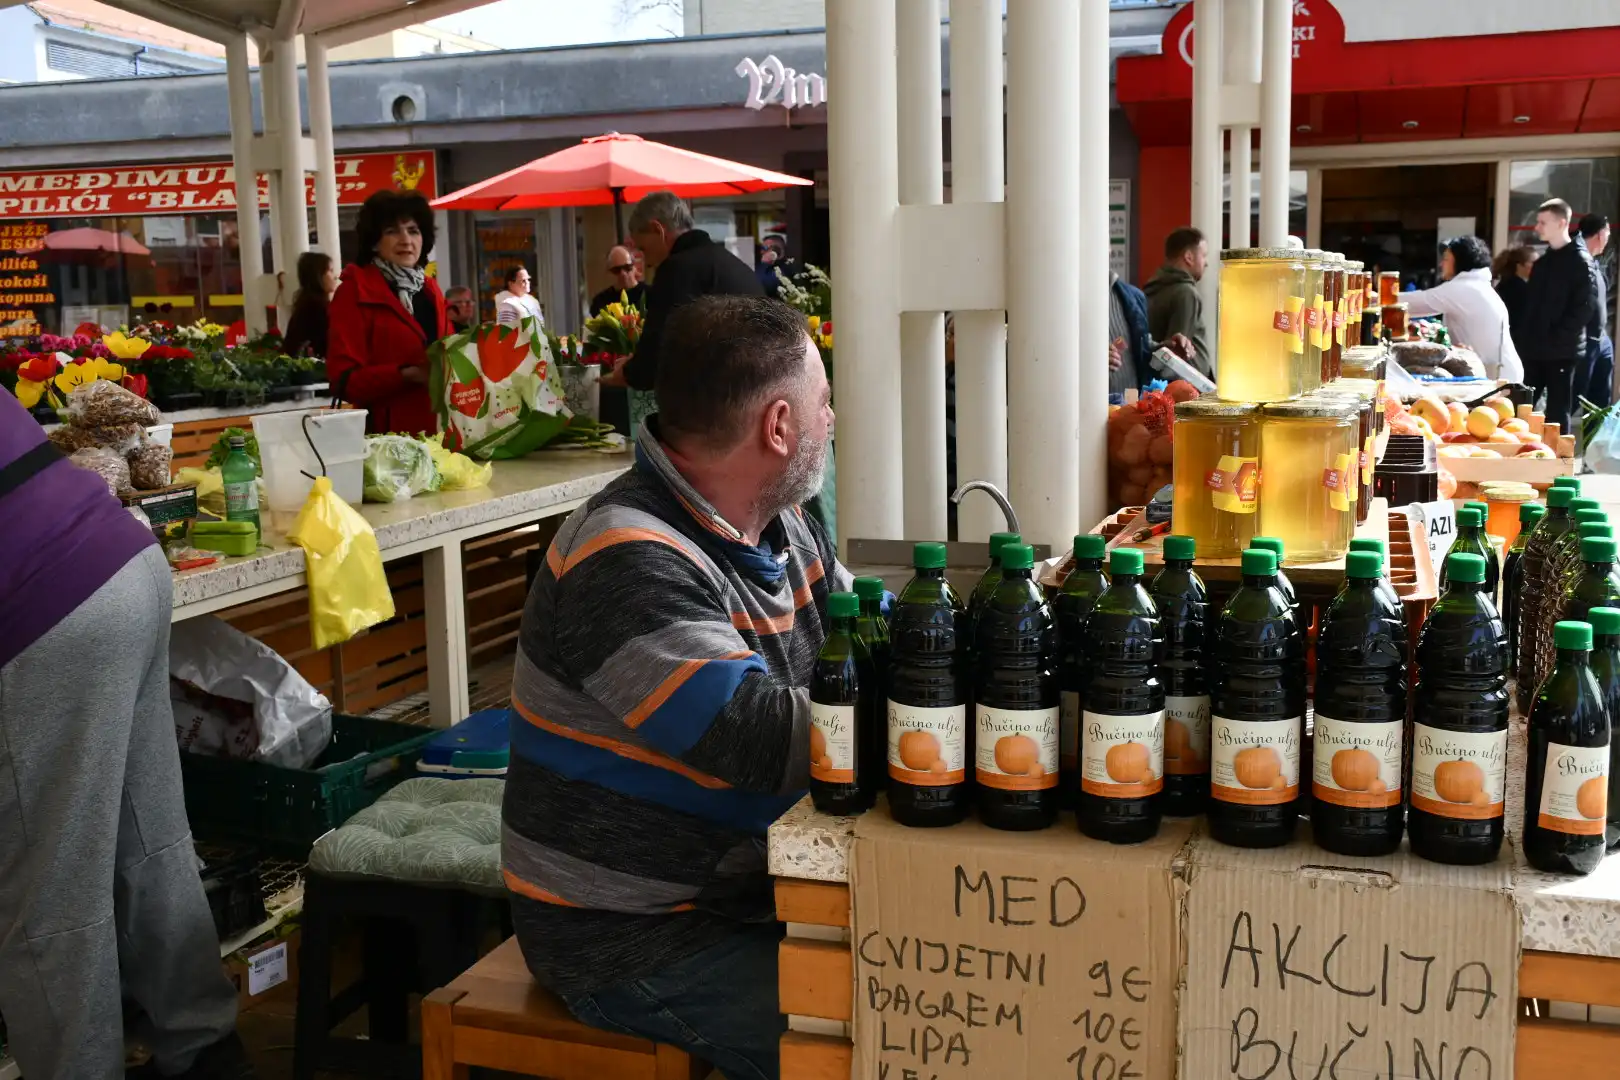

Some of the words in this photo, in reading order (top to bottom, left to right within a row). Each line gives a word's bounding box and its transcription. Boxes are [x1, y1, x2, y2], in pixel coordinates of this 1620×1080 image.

[0, 189, 113, 214] PILIĆI
[0, 256, 39, 270] ilića
[1430, 515, 1451, 537] AZI
[823, 713, 848, 737] ulje
[889, 708, 934, 728] Bučino
[937, 714, 961, 739] ulje
[980, 713, 1032, 732] Bučino
[1035, 716, 1056, 741] ulje
[1088, 722, 1143, 742] Bučino
[1217, 726, 1273, 747] Bučino
[1278, 727, 1298, 752] ulje
[1317, 724, 1373, 745] Bučino
[1376, 730, 1401, 757] ulje
[1419, 735, 1477, 757] Bučino
[954, 864, 1087, 928] MED
[858, 930, 1046, 987] CVIJETNI
[1220, 910, 1498, 1019] AKCIJA
[867, 975, 1024, 1036] BAGREM
[880, 1020, 972, 1067] LIPA
